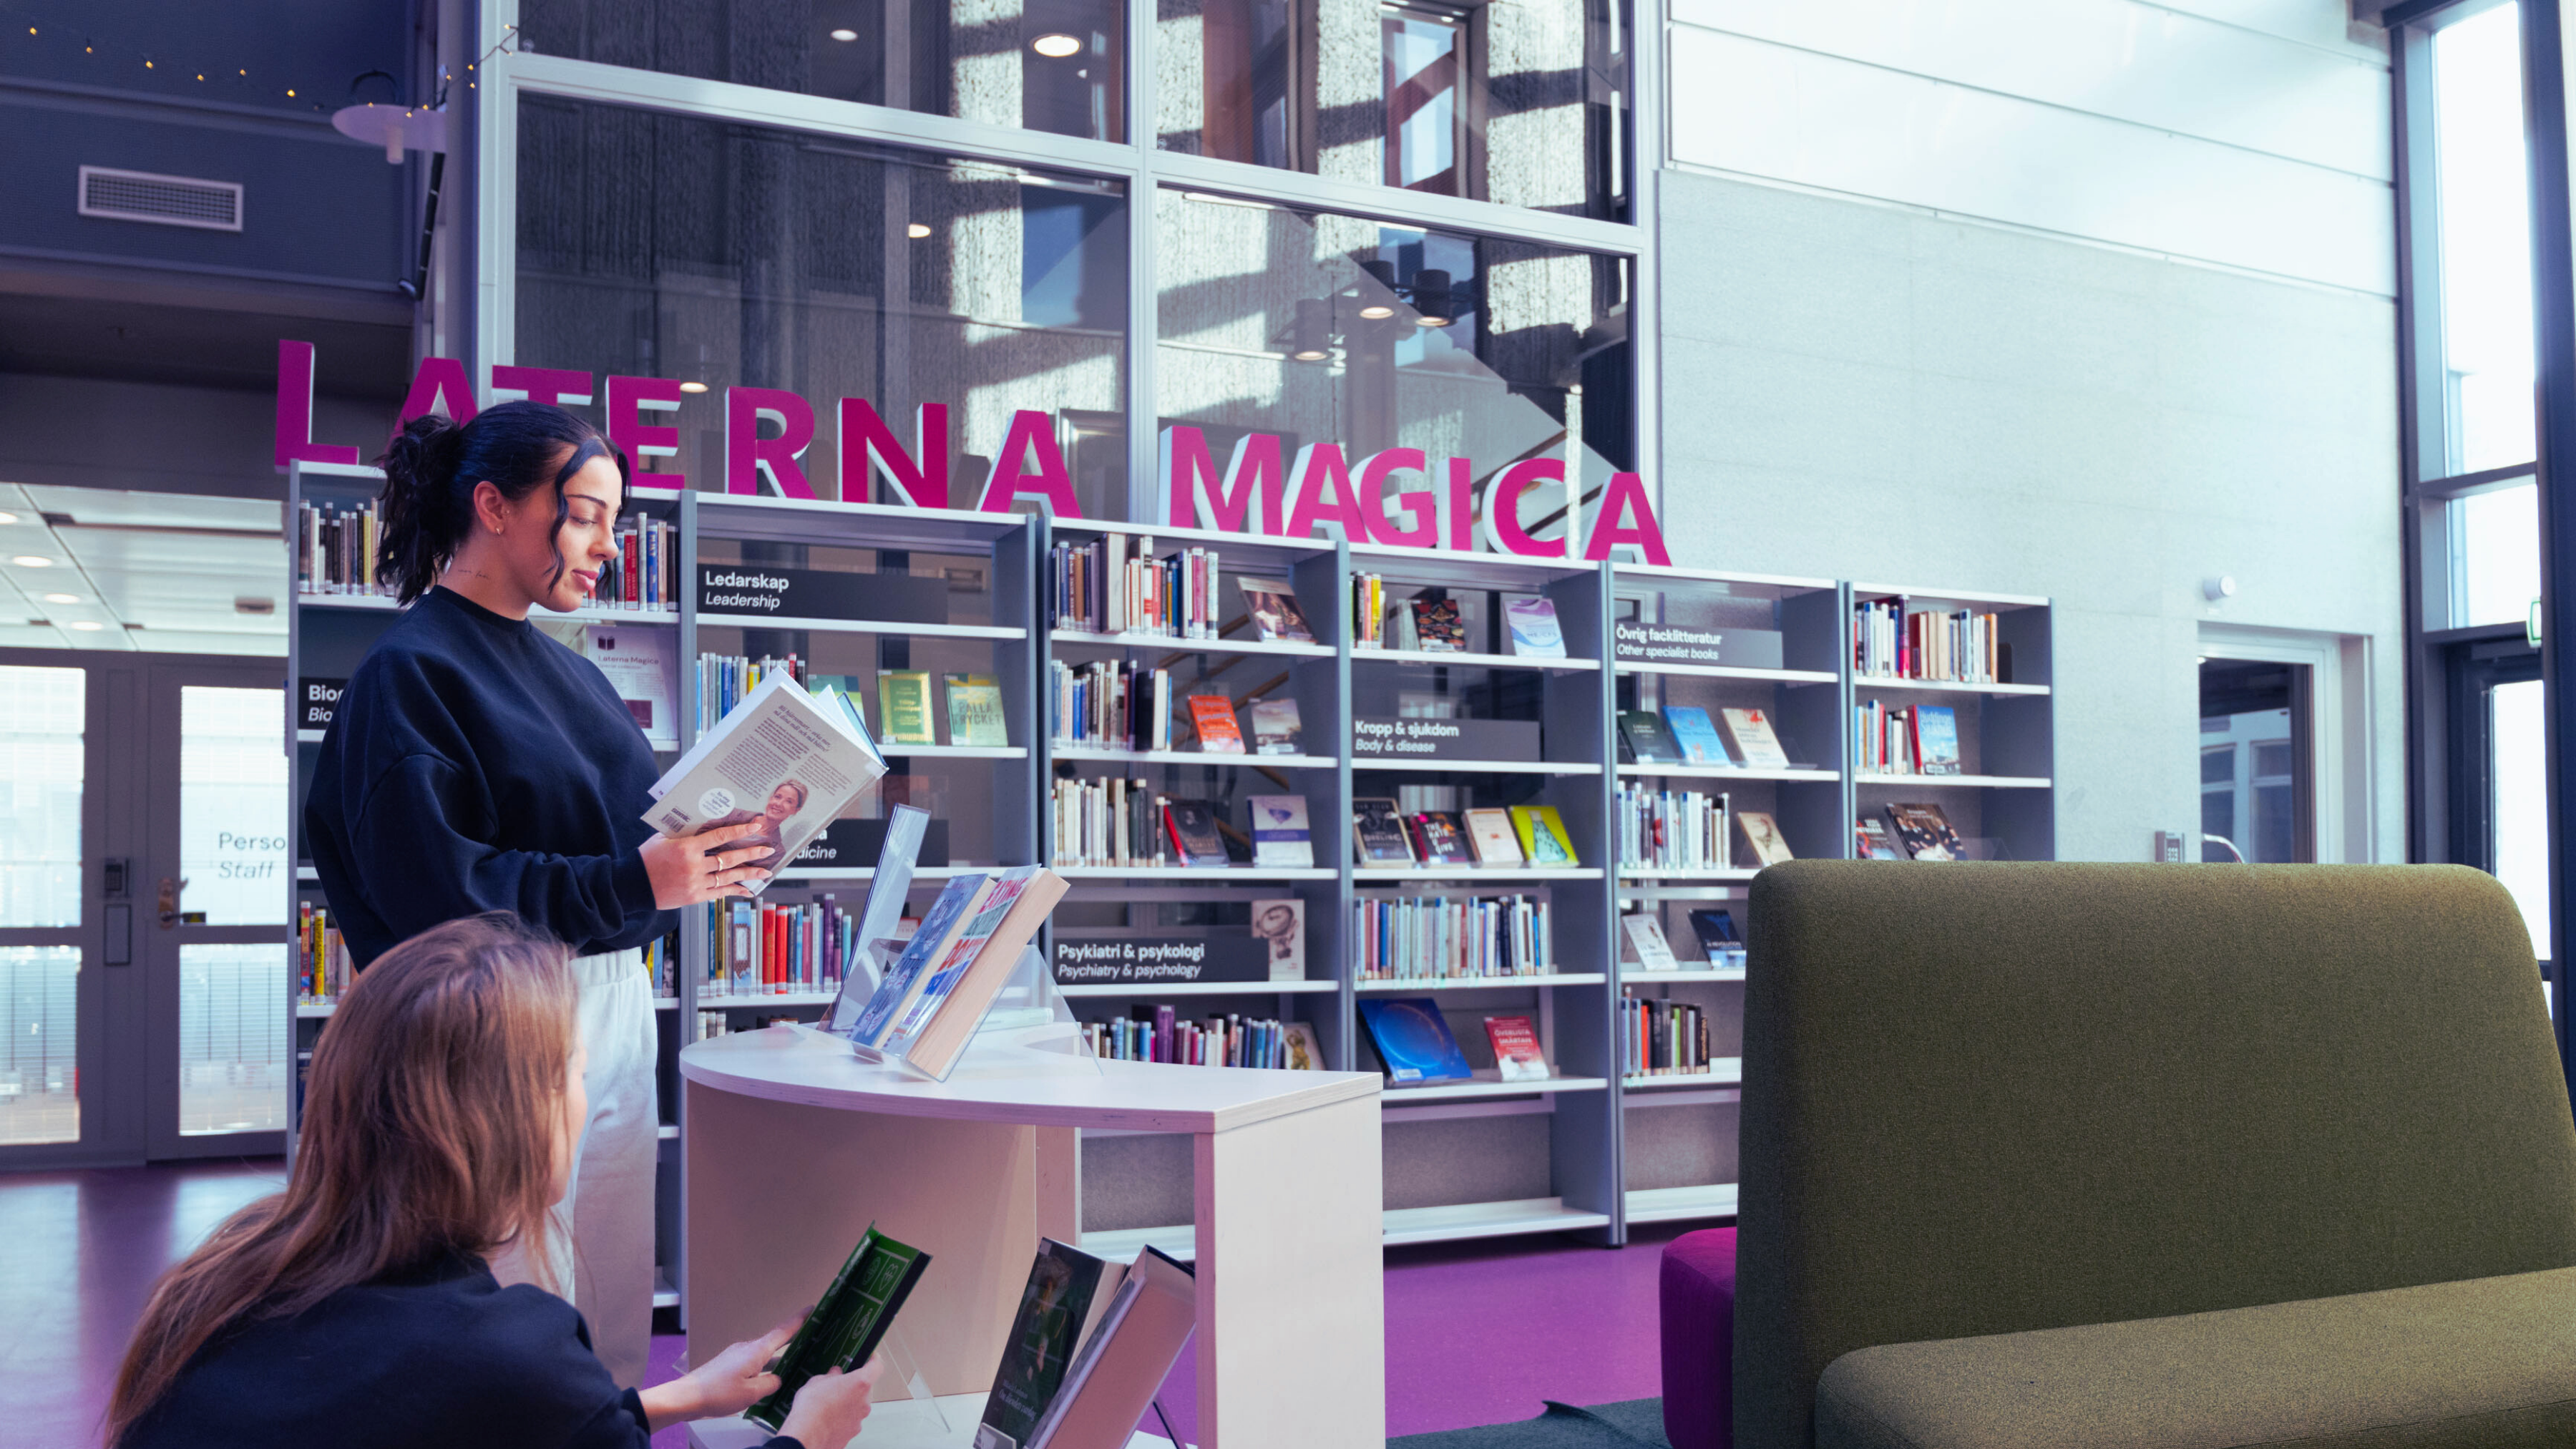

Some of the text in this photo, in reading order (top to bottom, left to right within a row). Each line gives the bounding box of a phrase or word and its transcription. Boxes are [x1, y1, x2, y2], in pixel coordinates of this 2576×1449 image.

[275, 339, 1673, 567] LATERNA MAGICA
[705, 571, 789, 592] Ledarskap
[705, 592, 781, 611] Leadership
[1616, 623, 1722, 646] Övrig facklitteratur
[1616, 643, 1719, 660] Other specialist books
[630, 656, 660, 665] Magica
[958, 701, 994, 713] PALLA
[953, 713, 1002, 726] TRYCKET
[1355, 721, 1460, 739] Kropp & sjukdom
[1355, 739, 1436, 753] Body & disease
[1425, 822, 1440, 831] THE
[1428, 829, 1450, 839] HATE
[1435, 842, 1455, 854] GIVE
[218, 860, 274, 879] Staff
[977, 877, 1029, 914] EATING
[1058, 943, 1206, 961] Psykiatri & psykologi
[1058, 963, 1202, 980] Psychiatry & psychology
